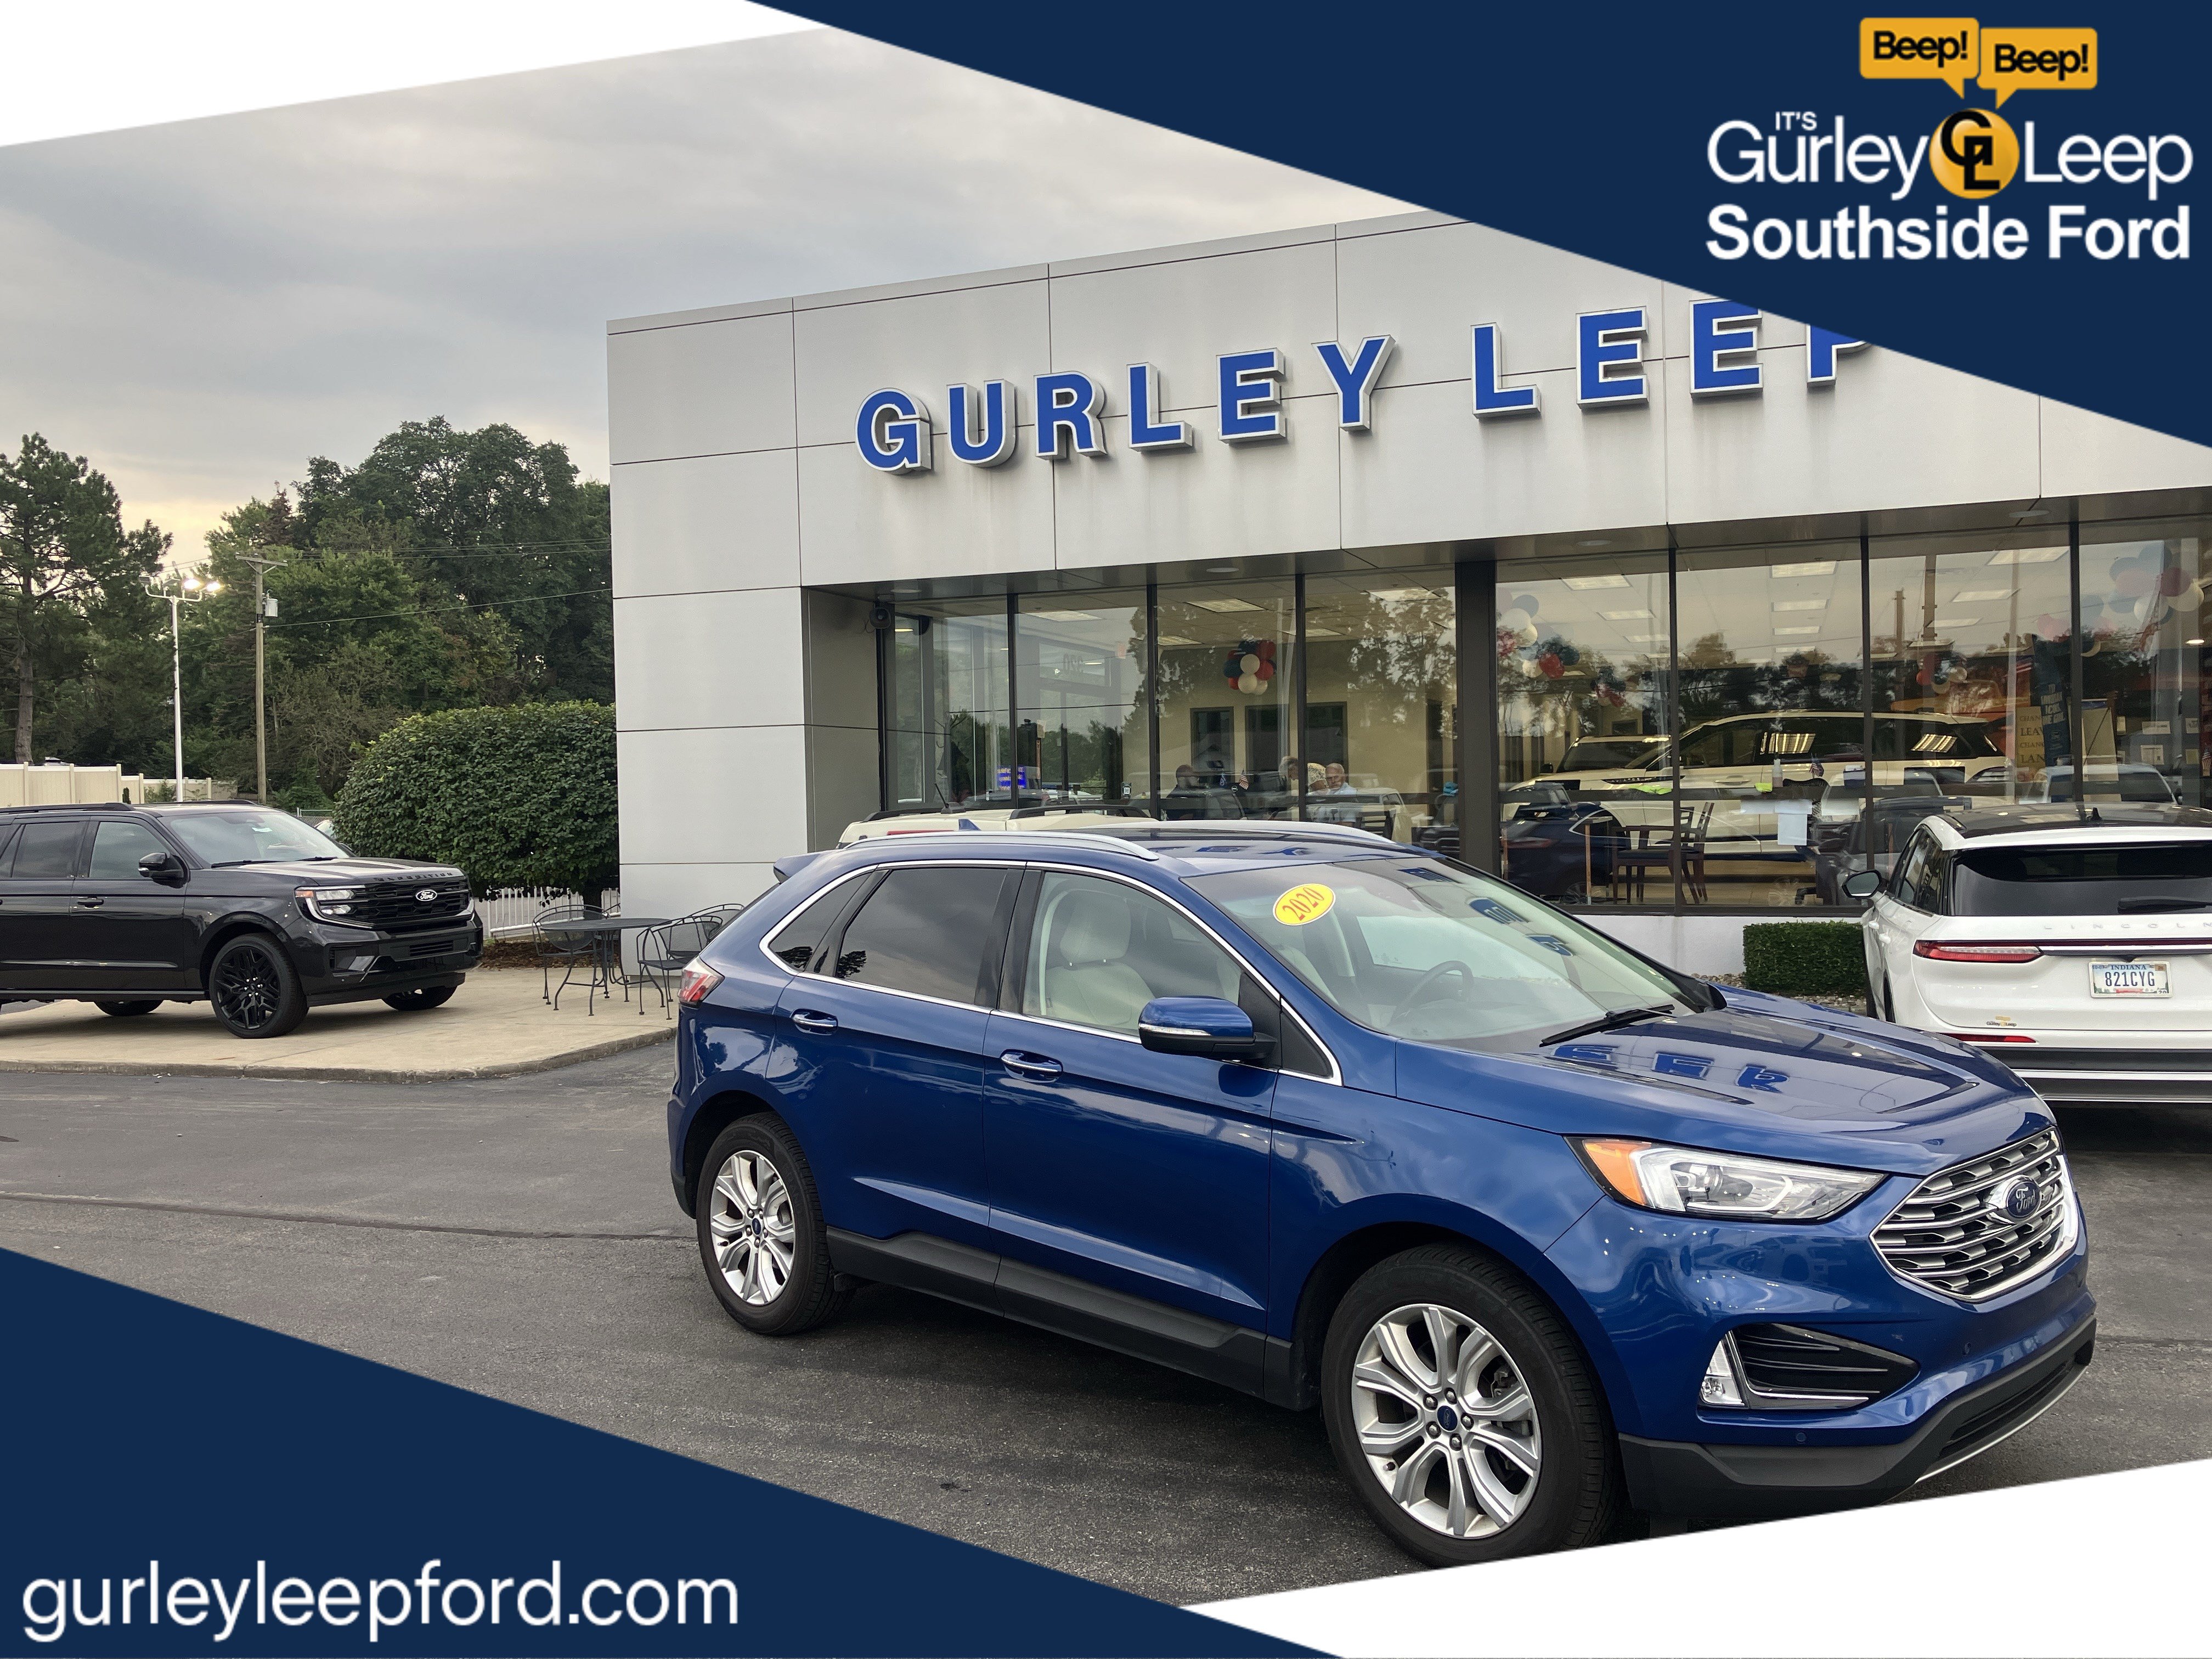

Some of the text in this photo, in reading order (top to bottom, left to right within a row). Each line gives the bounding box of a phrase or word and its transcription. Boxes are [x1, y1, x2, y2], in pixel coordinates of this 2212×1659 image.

[855, 336, 1392, 474] GURLEY
[420, 890, 435, 900] Ford
[1282, 887, 1324, 921] 2020
[2104, 971, 2155, 987] 821CYG
[2016, 1187, 2036, 1212] Ford
